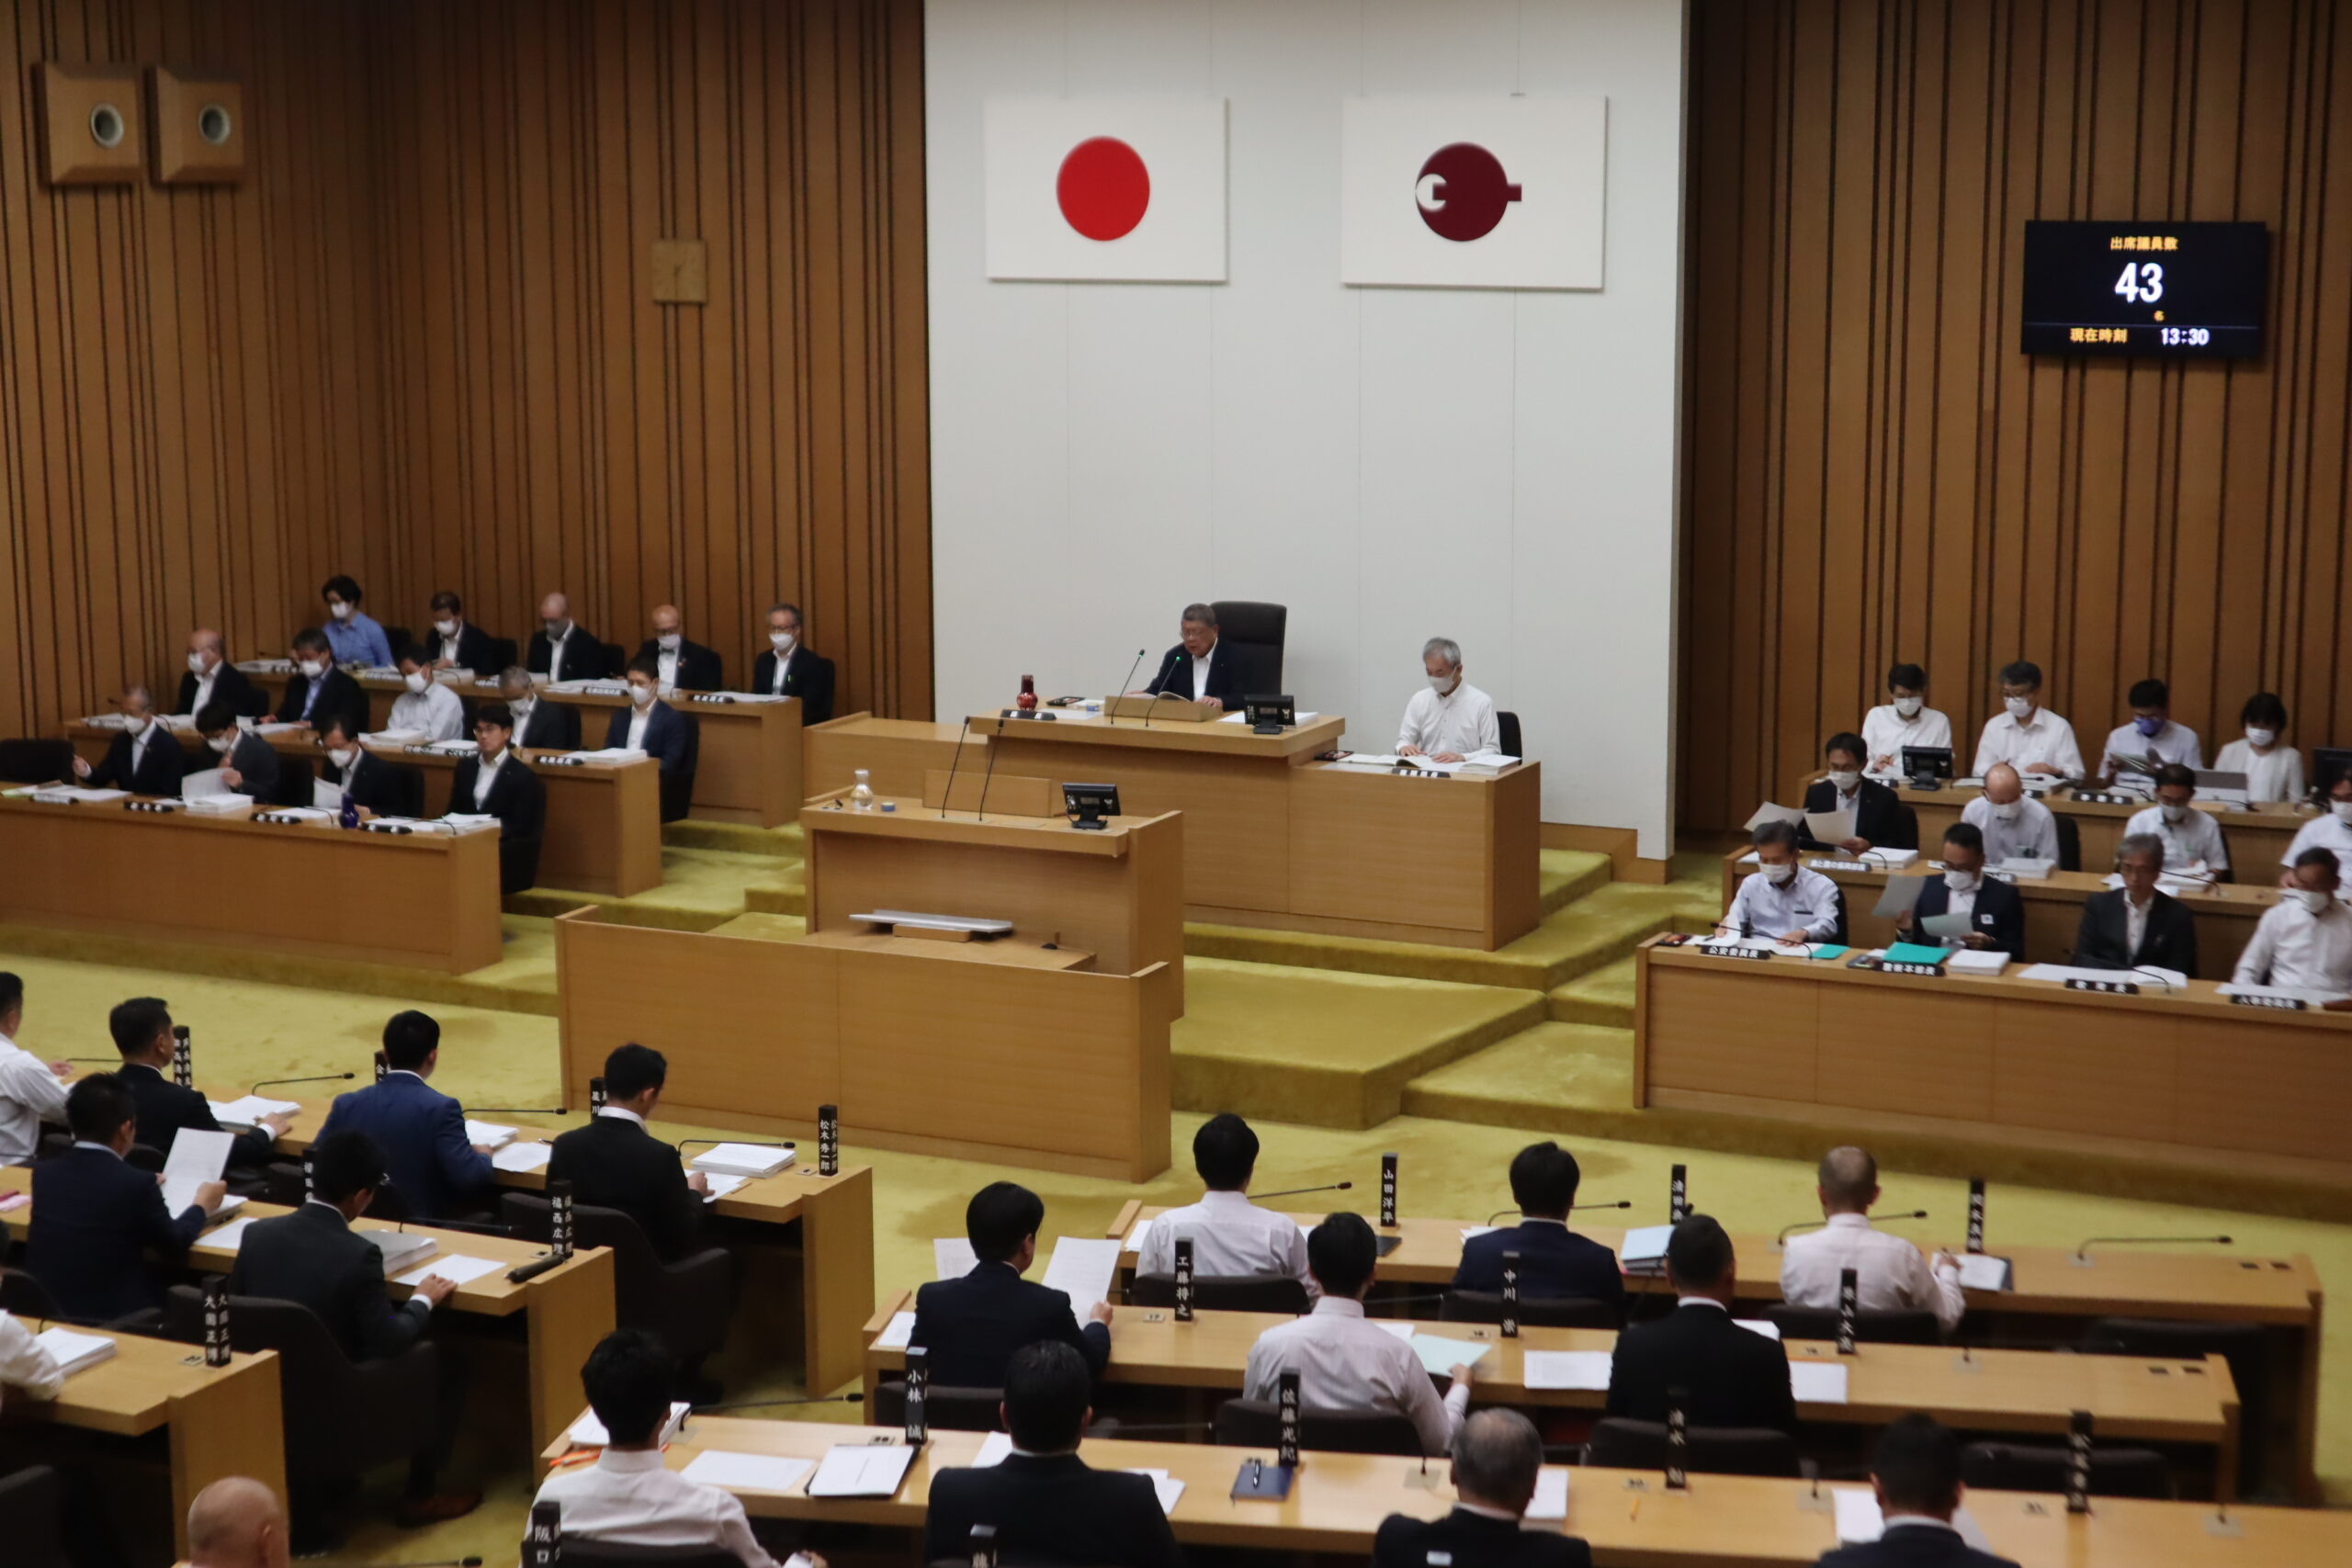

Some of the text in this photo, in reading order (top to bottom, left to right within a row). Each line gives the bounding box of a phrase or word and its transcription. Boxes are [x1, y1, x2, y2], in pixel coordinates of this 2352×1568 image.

[2110, 237, 2178, 251] 出席議員数
[2114, 263, 2163, 303] 43
[2070, 328, 2210, 345] 現在時刻 13:30
[820, 1119, 831, 1171] 松木秀一郎
[1382, 1168, 1394, 1224] 山田洋平
[551, 1196, 563, 1256] 福西広理
[1176, 1256, 1190, 1316] 工藤将之
